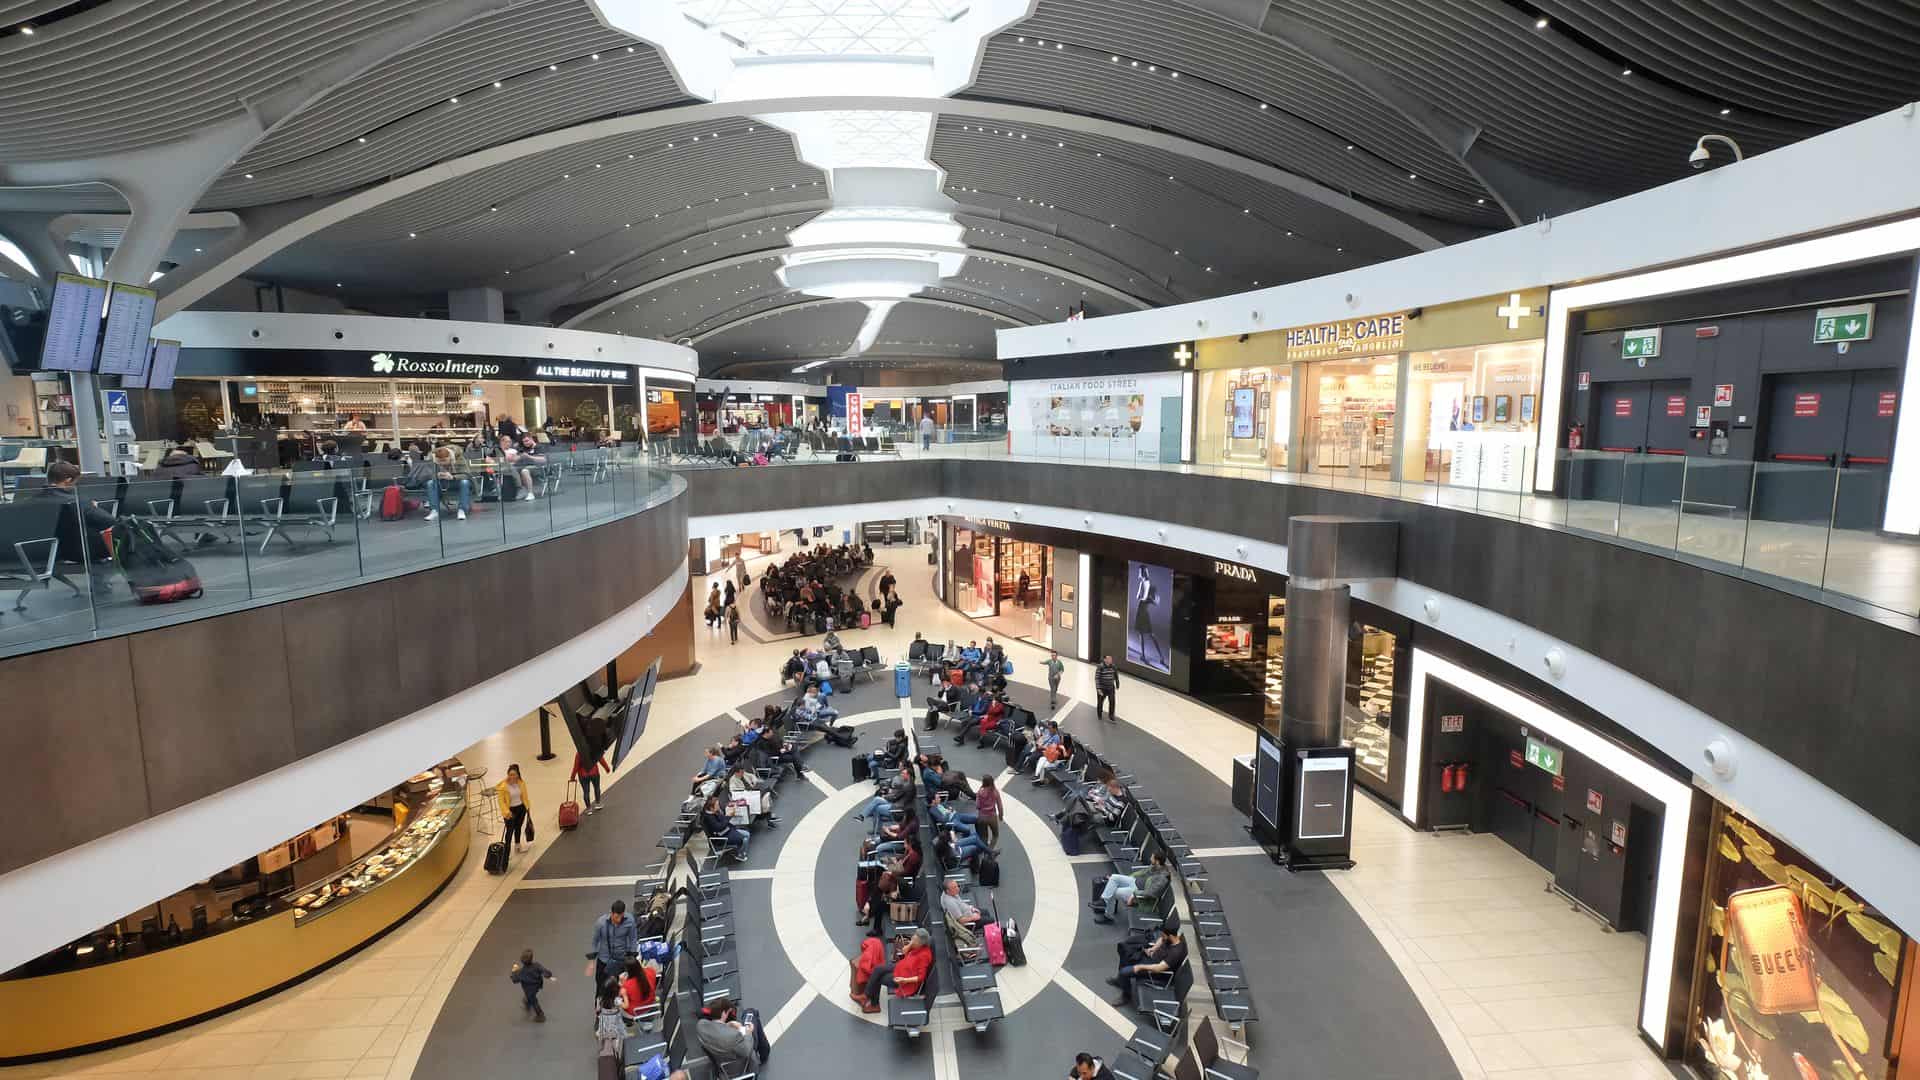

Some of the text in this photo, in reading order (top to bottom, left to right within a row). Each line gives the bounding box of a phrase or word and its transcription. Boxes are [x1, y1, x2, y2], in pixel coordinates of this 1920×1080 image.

[1286, 316, 1404, 347] HEALTH CARE
[536, 366, 553, 376] ALL
[570, 367, 600, 378] BEAUTY
[1050, 379, 1137, 391] ITALIAN FOOD STREET
[1215, 561, 1257, 583] PRADA
